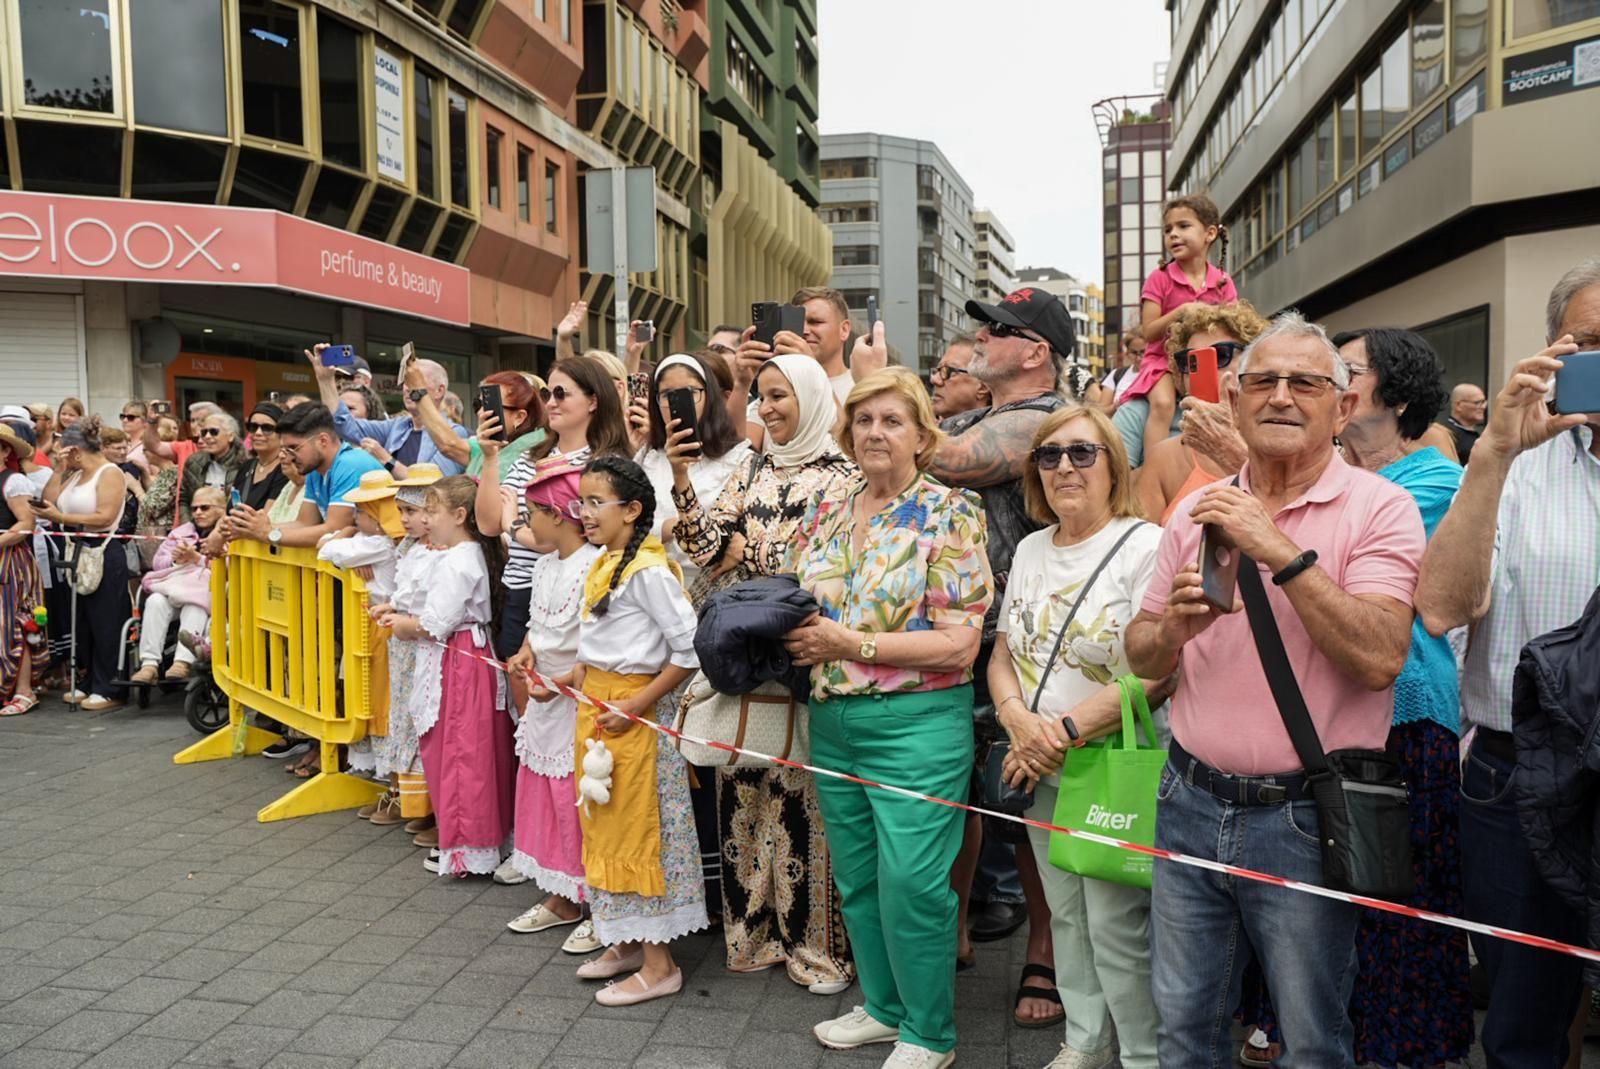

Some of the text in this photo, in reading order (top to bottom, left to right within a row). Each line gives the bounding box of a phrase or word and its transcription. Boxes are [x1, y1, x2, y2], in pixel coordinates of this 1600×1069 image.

[375, 55, 398, 76] LOCAL
[1509, 69, 1572, 92] BOOTCAMP
[321, 249, 442, 303] perfume & beauty
